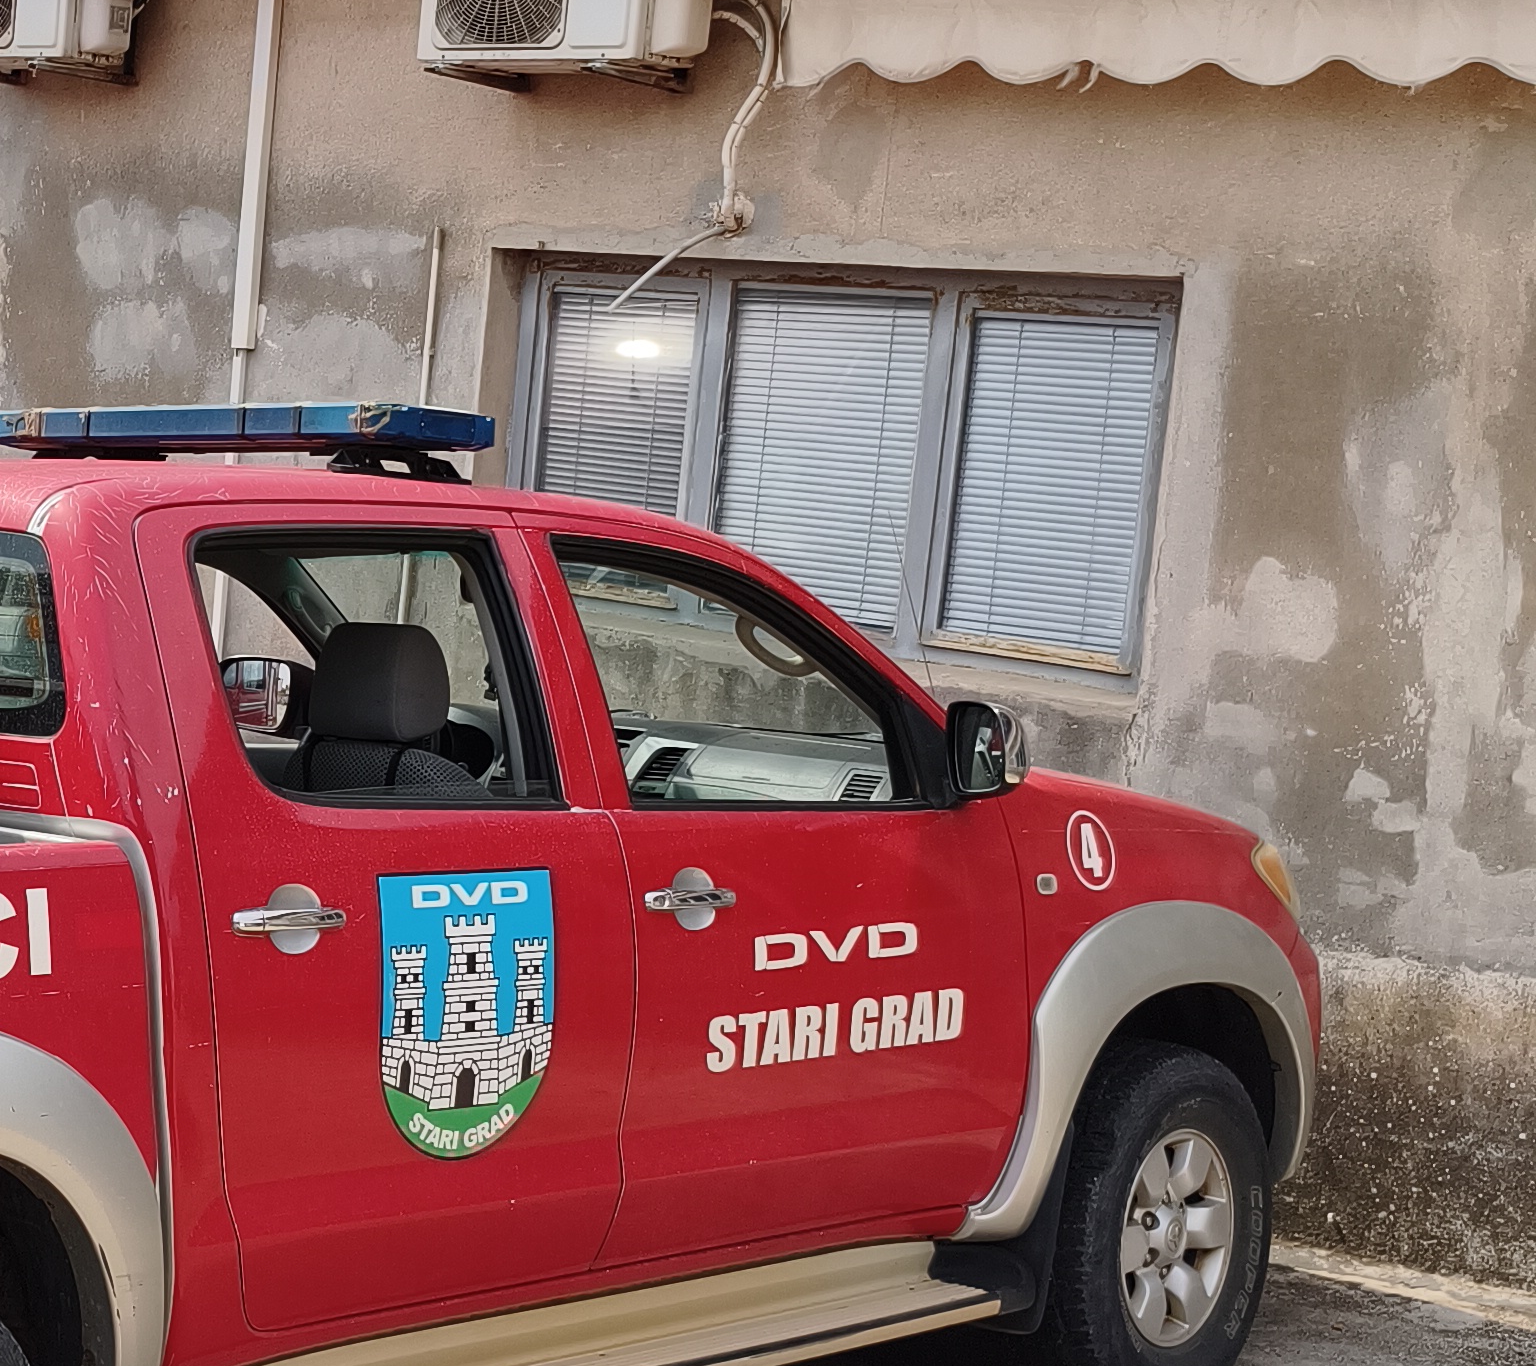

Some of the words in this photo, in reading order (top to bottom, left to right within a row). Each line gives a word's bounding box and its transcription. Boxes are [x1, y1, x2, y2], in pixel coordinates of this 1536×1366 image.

[1080, 822, 1104, 878] 4
[411, 880, 529, 909] DVD
[754, 922, 918, 972] DVD
[706, 1002, 839, 1073] STARI
[849, 987, 964, 1054] GRAD
[408, 1112, 459, 1150] STARI
[463, 1103, 516, 1148] GRAD
[1223, 1186, 1263, 1340] COOPER
